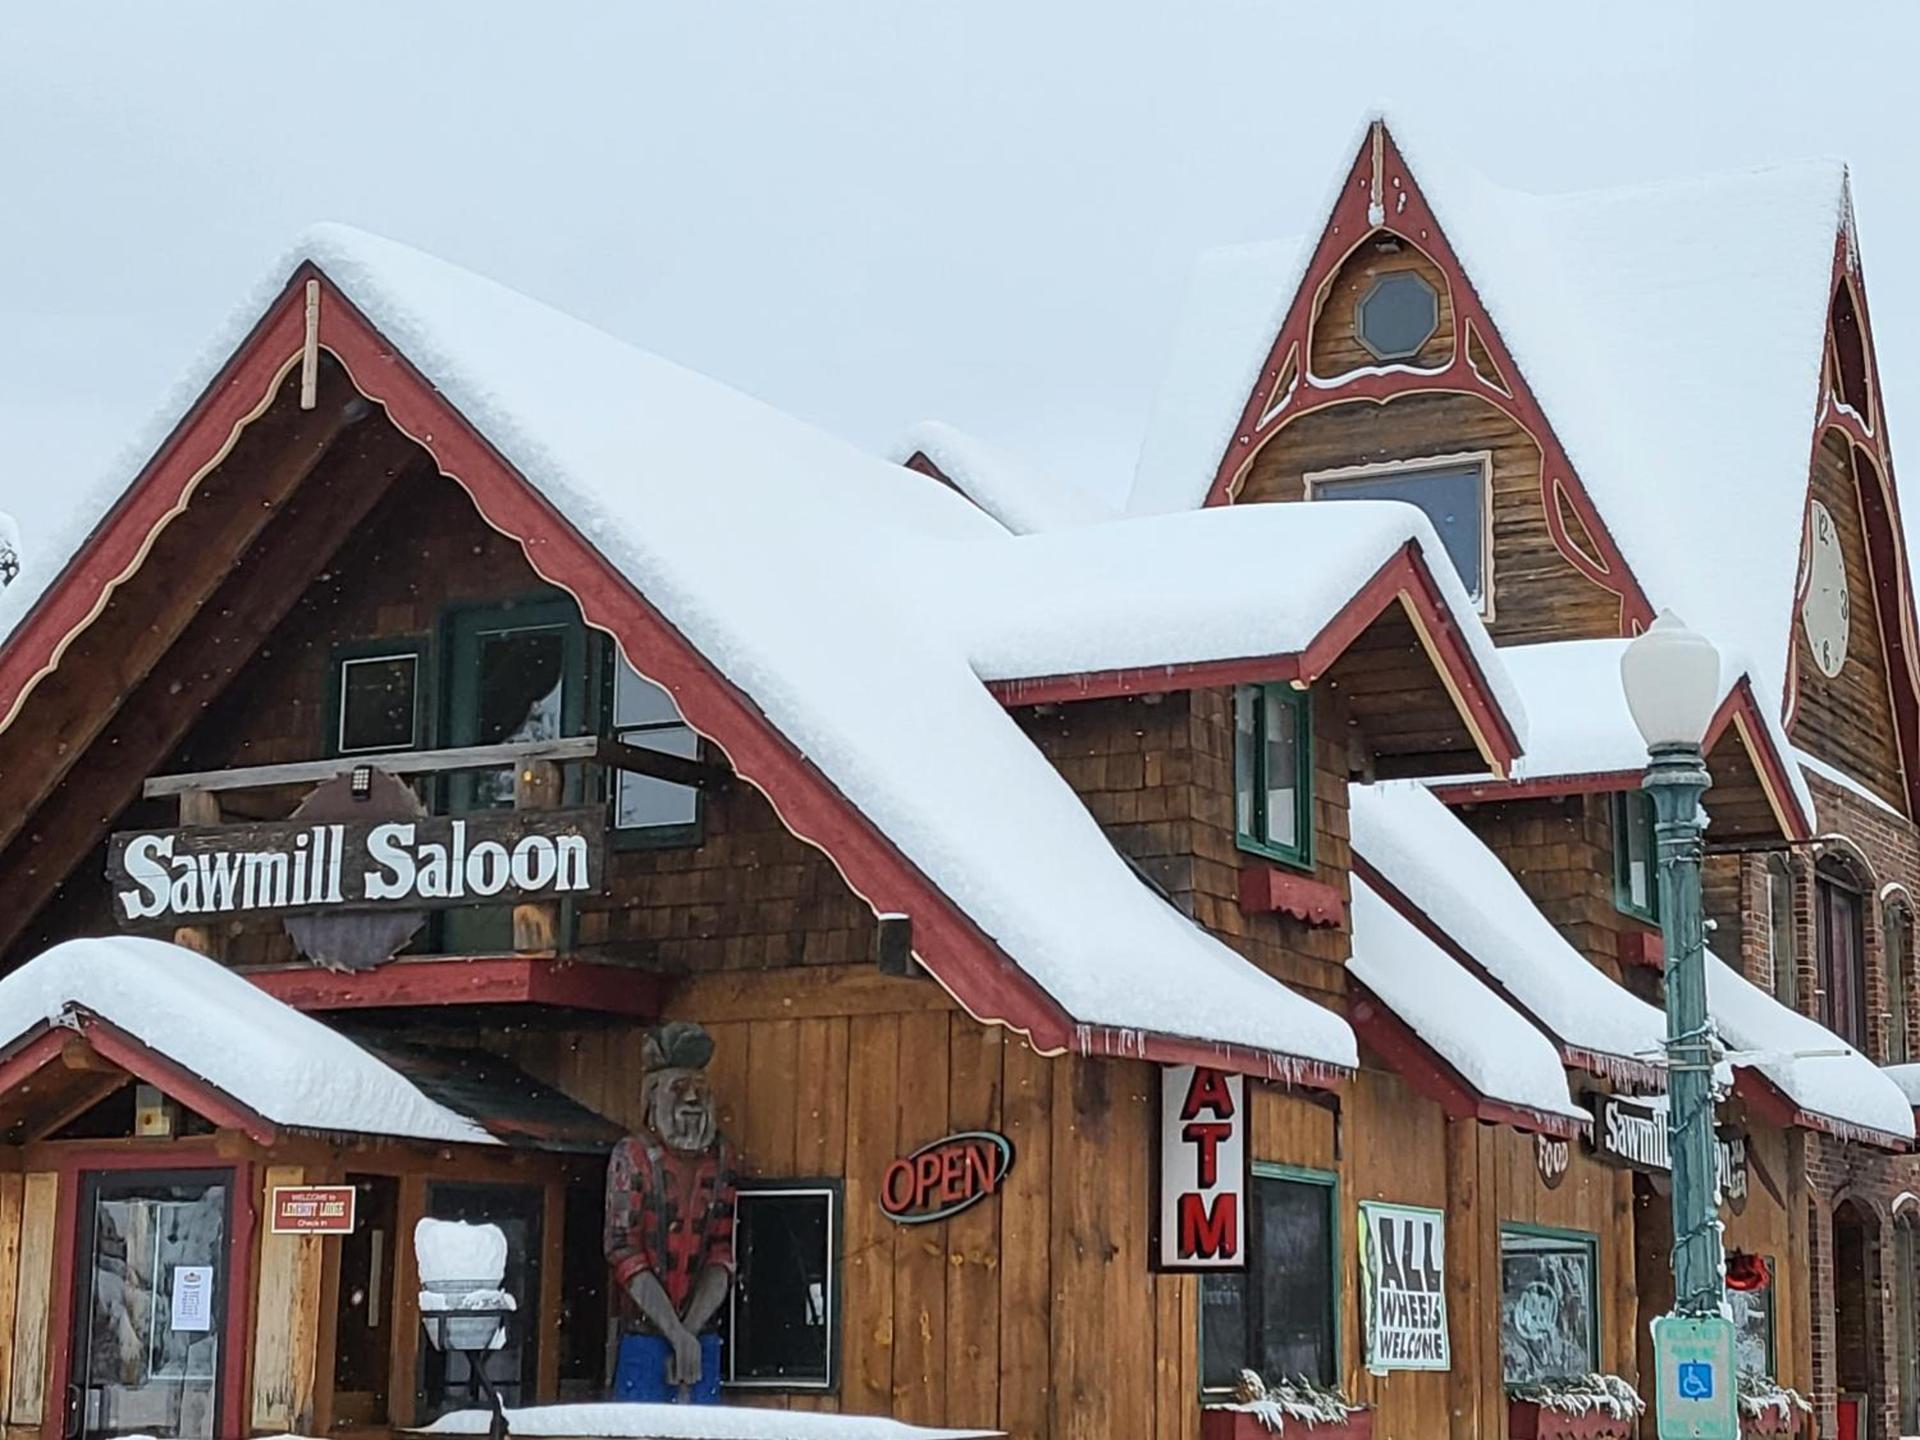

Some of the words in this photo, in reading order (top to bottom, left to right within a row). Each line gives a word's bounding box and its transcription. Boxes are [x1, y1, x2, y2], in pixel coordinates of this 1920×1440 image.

[119, 824, 344, 920] Sawmill
[364, 820, 589, 900] Saloon
[882, 1142, 996, 1212] OPEN
[1177, 1066, 1237, 1259] ATM
[1537, 1133, 1569, 1179] FOOD
[291, 1193, 328, 1201] WELCOME
[1379, 1216, 1441, 1293] ALL
[1380, 1331, 1443, 1360] WELCOME
